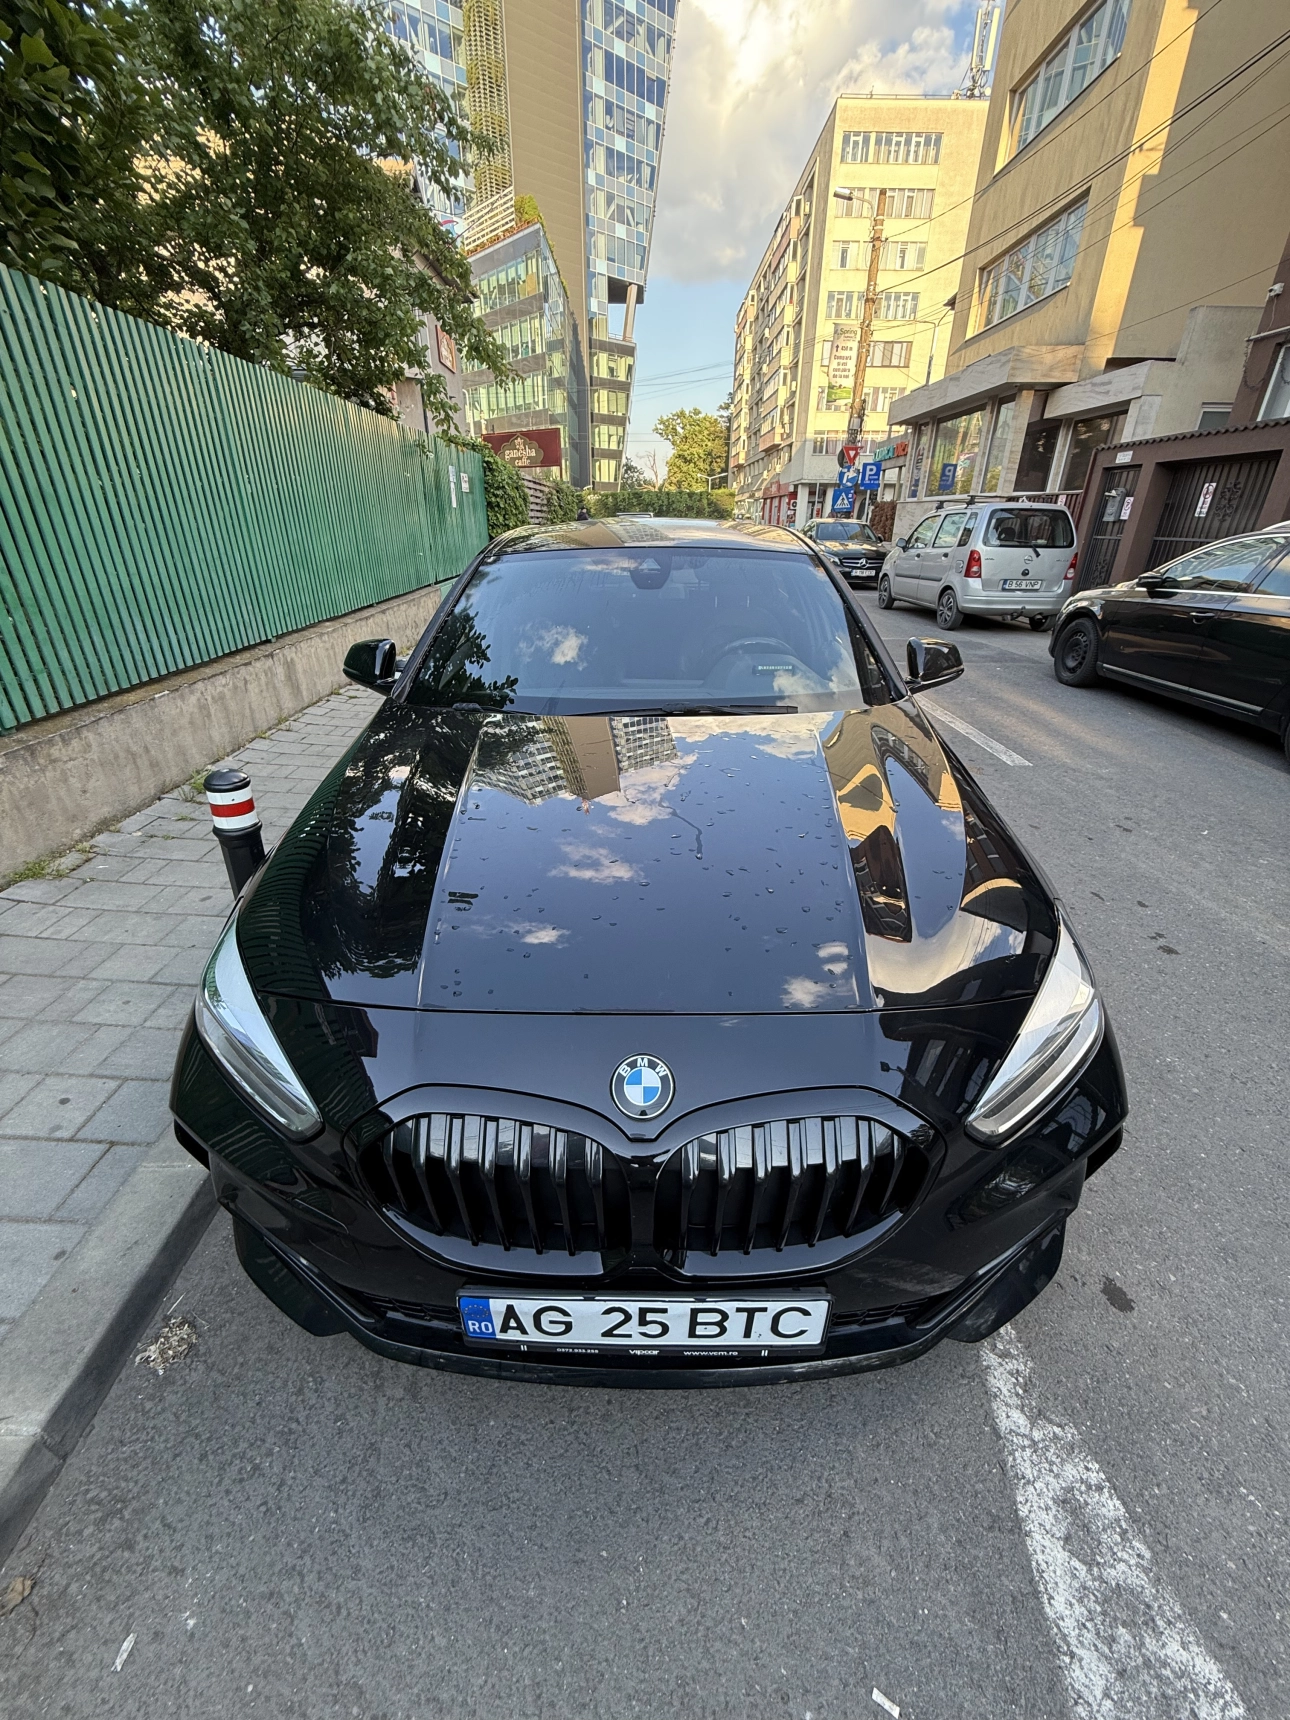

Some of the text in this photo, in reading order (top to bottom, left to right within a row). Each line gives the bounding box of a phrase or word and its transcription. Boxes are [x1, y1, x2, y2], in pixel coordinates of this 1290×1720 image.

[840, 328, 858, 336] Spring
[505, 445, 536, 461] ganesha
[515, 457, 531, 466] caffe
[865, 465, 877, 481] P
[619, 1057, 668, 1077] BMW
[468, 1320, 493, 1334] RO
[500, 1304, 812, 1339] AG 25 BTC
